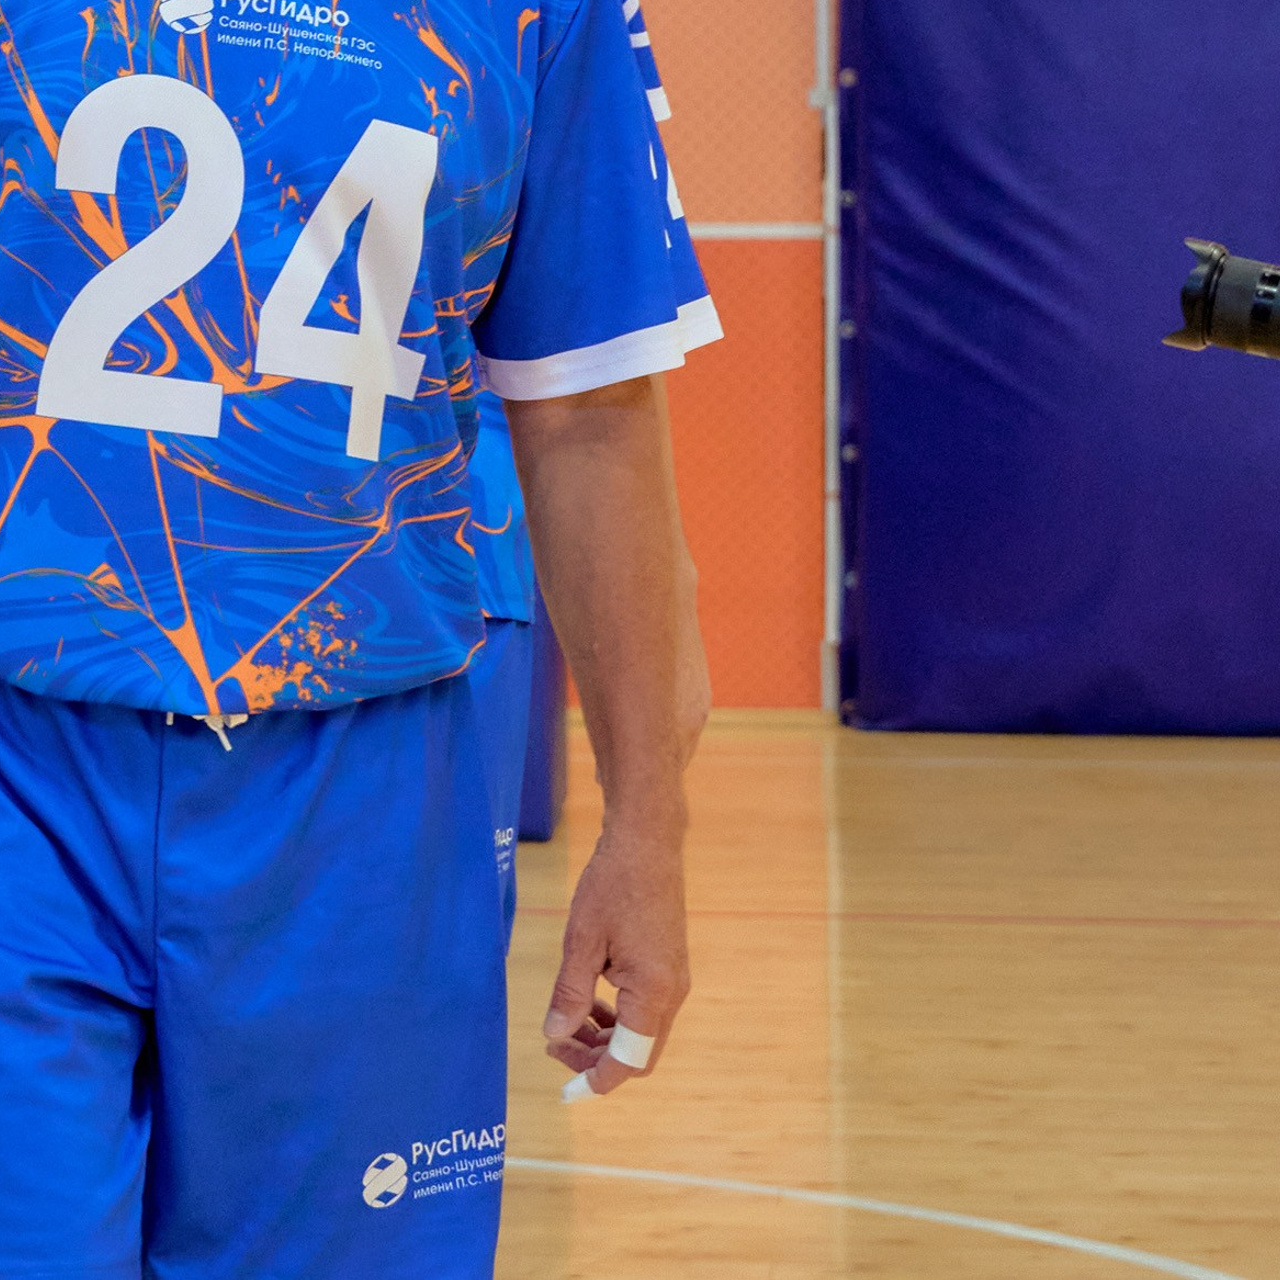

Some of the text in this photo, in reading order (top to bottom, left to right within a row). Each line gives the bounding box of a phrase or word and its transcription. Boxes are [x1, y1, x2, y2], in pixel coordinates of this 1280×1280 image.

[216, 32, 383, 71] имени П.С. Непорожнего
[218, 15, 377, 54] Саяно-Шушенская ГЭС
[36, 73, 438, 462] 24
[411, 1123, 506, 1166] РусГидр
[413, 1180, 454, 1200] имени
[455, 1173, 482, 1189] П.С.
